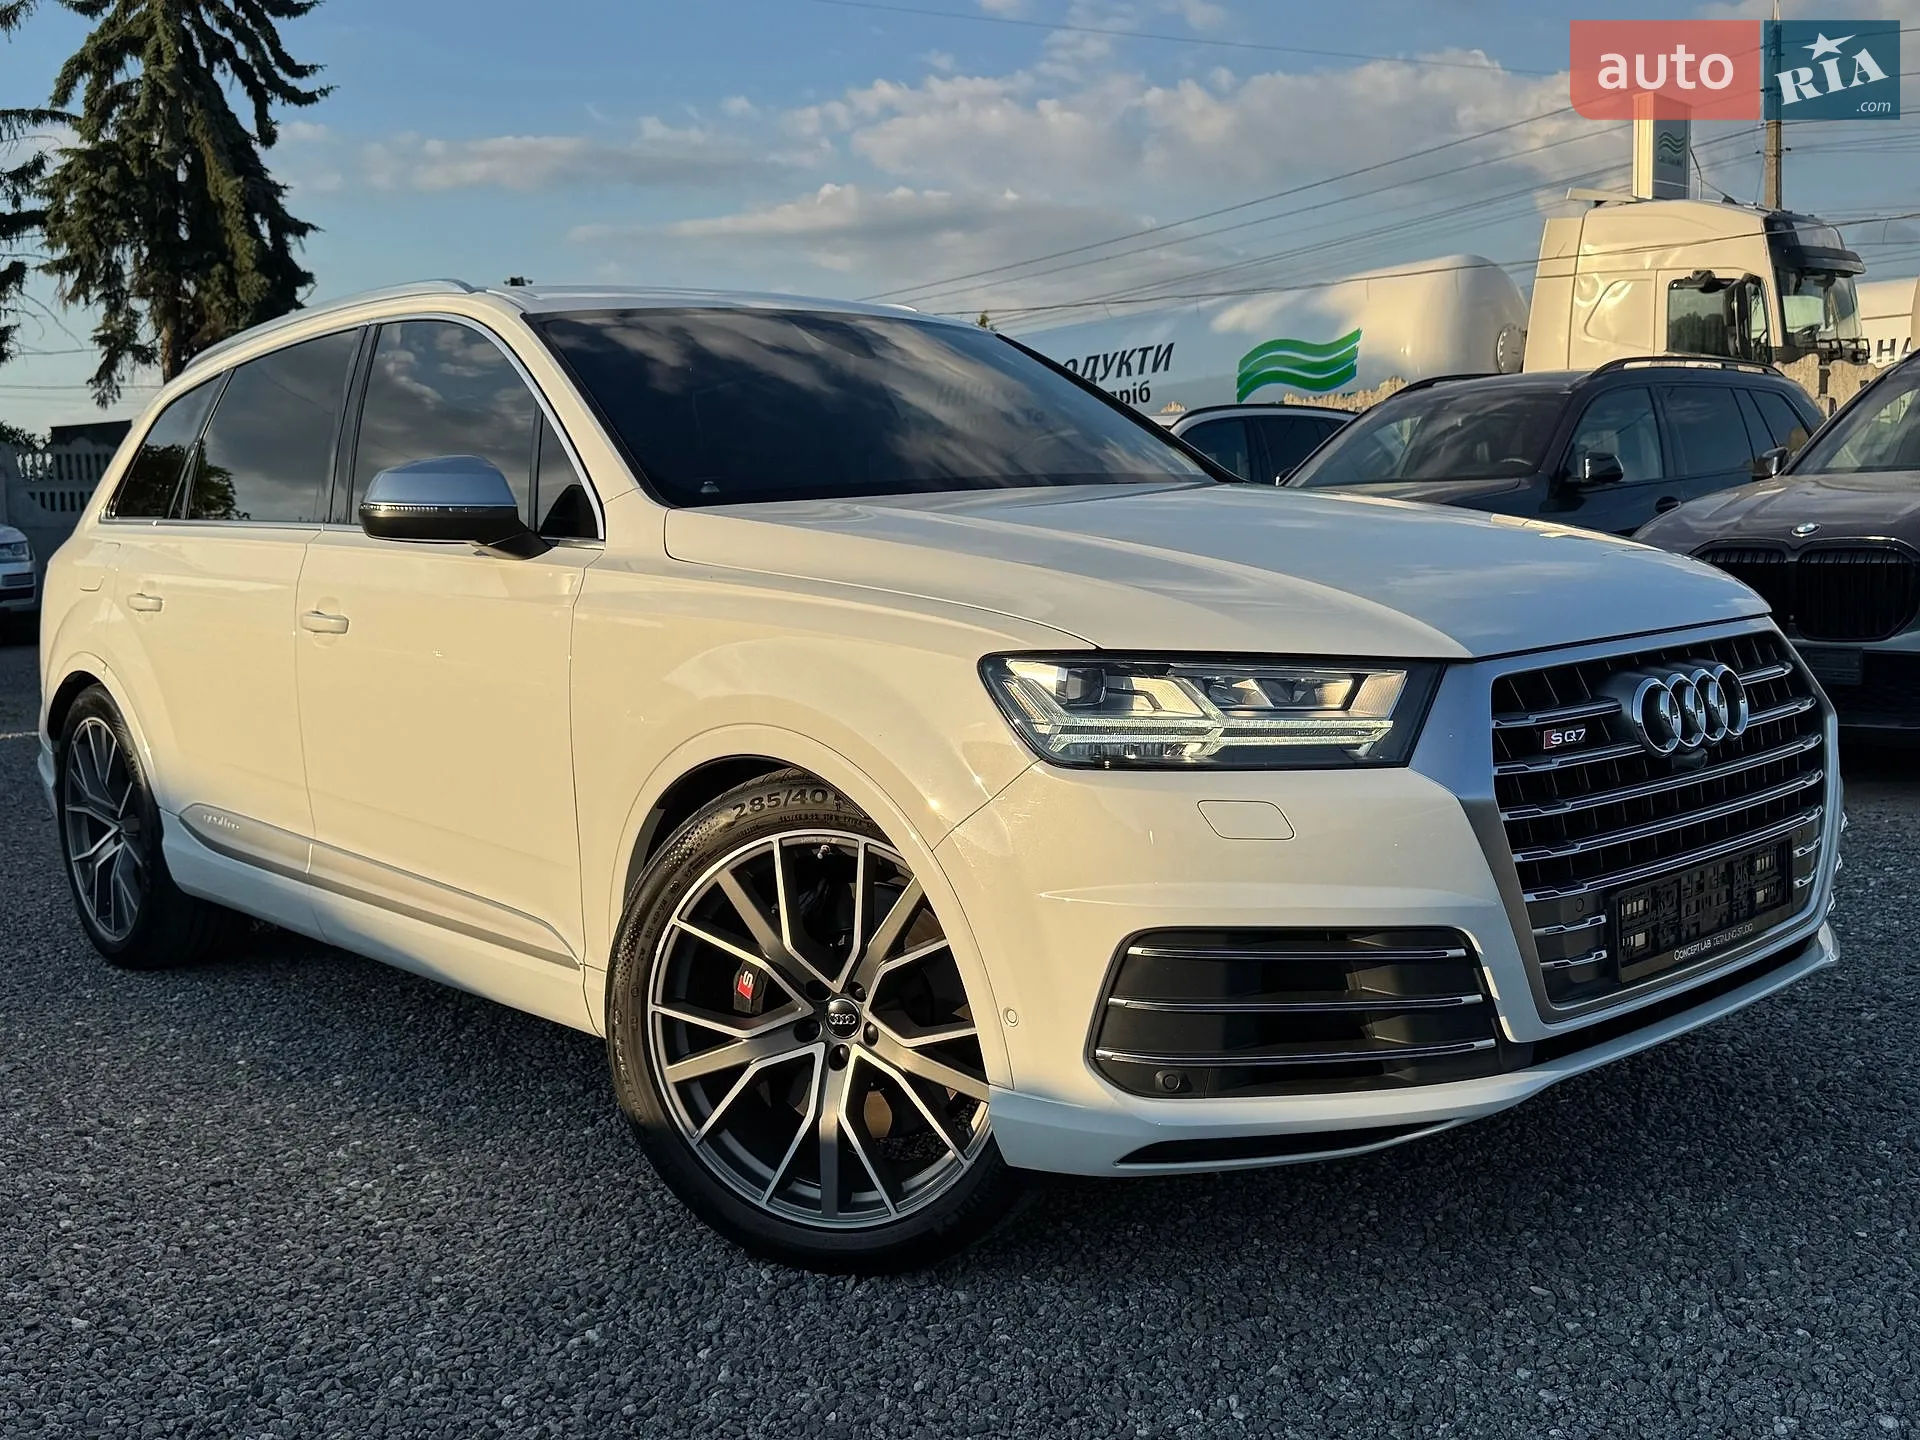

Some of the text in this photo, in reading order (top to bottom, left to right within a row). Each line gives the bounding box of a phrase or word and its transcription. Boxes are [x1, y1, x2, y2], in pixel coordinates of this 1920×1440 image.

[1109, 380, 1151, 405] ріб
[1550, 728, 1586, 746] SQ7
[732, 788, 828, 821] 285/40
[1700, 939, 1712, 951] LAB
